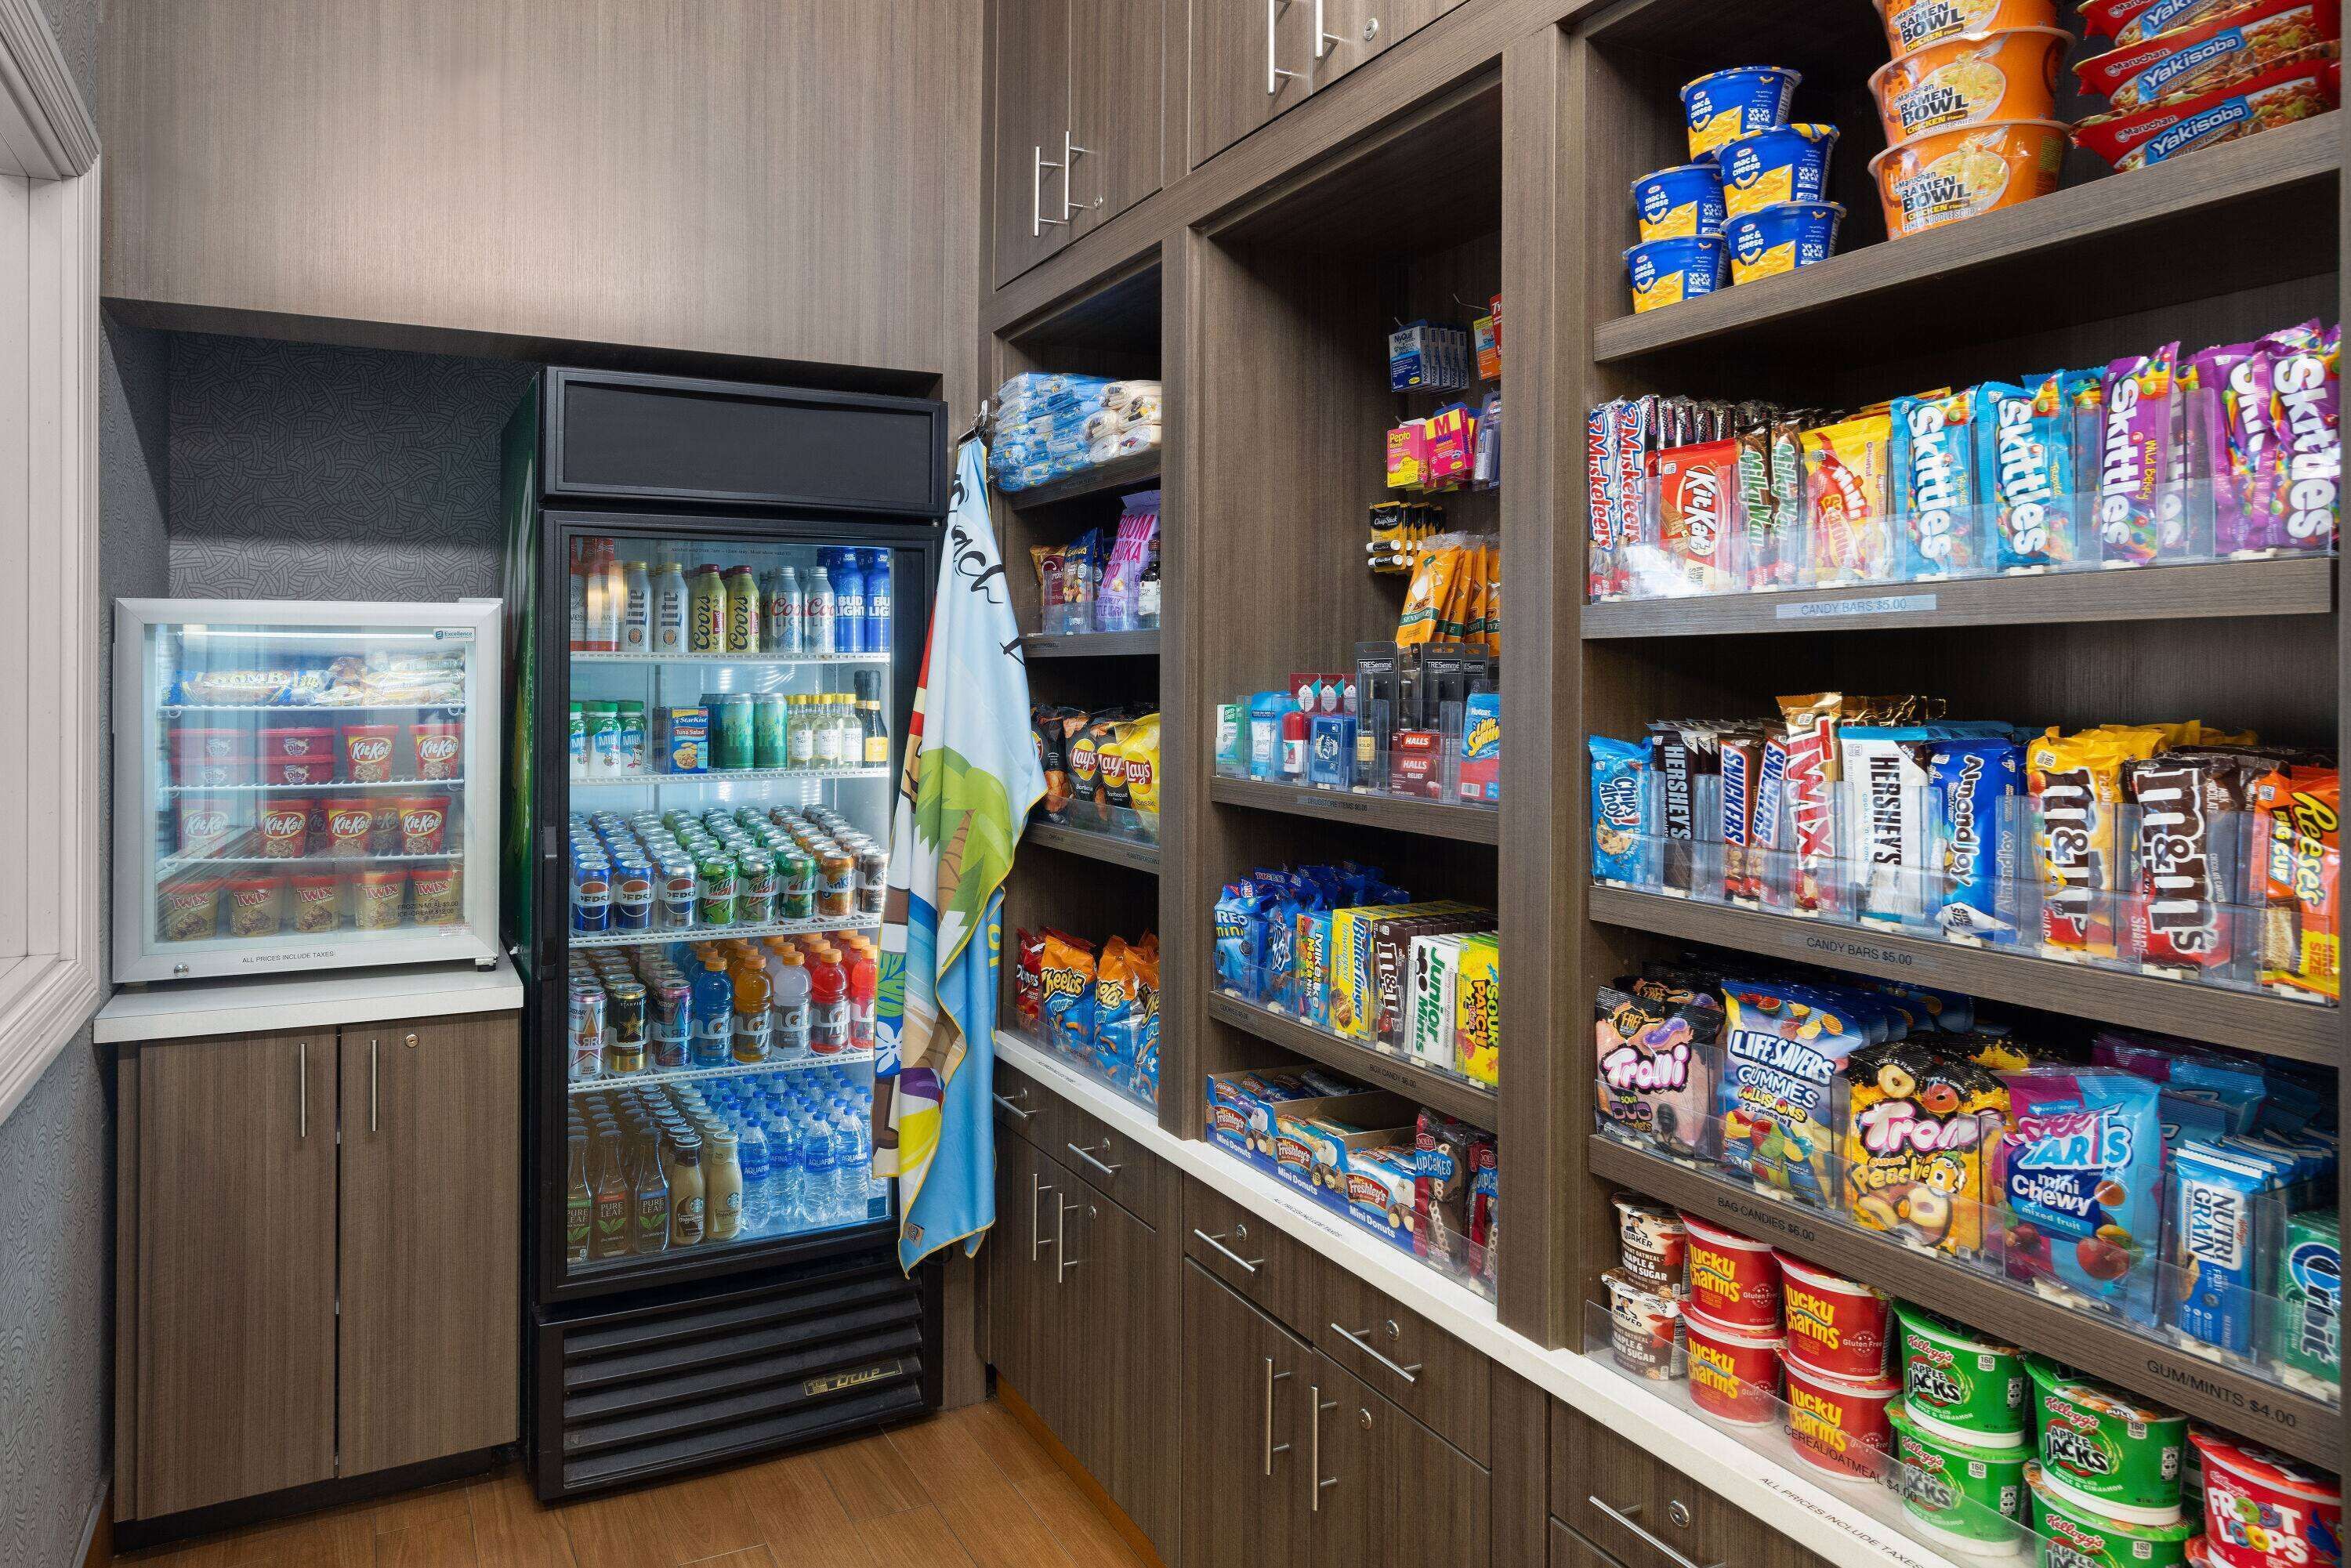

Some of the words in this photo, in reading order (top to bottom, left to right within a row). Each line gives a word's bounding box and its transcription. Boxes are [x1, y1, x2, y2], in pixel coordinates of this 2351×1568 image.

[1901, 2, 1949, 30] RAMEN
[1902, 9, 1965, 43] BOWL
[2115, 49, 2168, 70] Maruchan
[2142, 36, 2237, 89] Yakisoba
[1691, 103, 1713, 119] cheese
[1900, 87, 1954, 114] RAMEN
[1902, 95, 1969, 127] BOWL
[1907, 116, 1947, 134] CHICKEN
[2125, 115, 2176, 136] Maruchan
[2153, 105, 2244, 156] Yakisoba
[1733, 161, 1760, 176] cheese
[1902, 176, 1955, 197] RAMEN
[1903, 183, 1971, 212] BOWL
[1645, 197, 1669, 212] cheese
[1737, 237, 1763, 251] cheese
[1635, 267, 1655, 281] cheese
[2103, 378, 2140, 545] Skittles
[2145, 440, 2157, 468] Wild
[1907, 406, 1958, 559] Skittles
[1998, 398, 2050, 554] Skittles
[838, 596, 863, 606] BUD
[1802, 603, 1839, 615] CANDY
[1842, 601, 1872, 613] BARS
[1877, 599, 1907, 610] $5.00
[694, 595, 711, 650] Coors
[729, 595, 748, 650] Coors
[623, 736, 641, 744] MILK
[1405, 735, 1429, 745] HALLS
[1125, 762, 1150, 784] Lay's
[1403, 760, 1427, 770] HALLS
[1664, 744, 1692, 839] HERSHEY'S
[1723, 747, 1744, 846] SNICKERS
[1954, 755, 1984, 852] Almond
[1870, 757, 1902, 865] HERSHEY'S
[2273, 810, 2292, 841] BIG
[2272, 842, 2293, 881] CUP
[2293, 791, 2338, 907] Reese's
[282, 952, 310, 961] INCLUDE
[313, 951, 334, 959] TAXES
[1806, 937, 1844, 952] CANDY
[1848, 944, 1878, 959] BARS
[1882, 951, 1912, 965] $5.00
[1353, 920, 1367, 1020] Butterfinger
[1427, 947, 1446, 1044] Junior
[1416, 995, 1428, 1053] Mints
[1473, 980, 1491, 1048] PATCH
[1487, 985, 1498, 1047] SOUR
[1605, 1044, 1690, 1088] Trolli
[1737, 1066, 1820, 1109] GUMMIES
[1751, 1106, 1780, 1121] FLAVORS
[1216, 1133, 1229, 1146] Mini
[1230, 1140, 1252, 1159] Donuts
[1277, 1143, 1310, 1164] Freshley's
[1277, 1166, 1292, 1181] Mini
[1293, 1175, 1317, 1196] Donuts
[1349, 1180, 1386, 1204] Freshley's
[2011, 1173, 2091, 1217] Chewy
[2038, 1171, 2080, 1195] mini
[643, 1198, 665, 1207] PURE
[1718, 1197, 1738, 1212] BAG
[1741, 1206, 1785, 1230] CANDIES
[1788, 1224, 1814, 1241] $6.00
[2021, 1204, 2053, 1222] mixed
[2056, 1214, 2082, 1232] fruit
[1349, 1205, 1366, 1222] Mini
[1367, 1215, 1396, 1238] Donuts
[2192, 1186, 2216, 1265] GRAIN
[2211, 1191, 2238, 1272] NUTRI
[1624, 1230, 1653, 1249] QUAKER
[1639, 1266, 1668, 1281] SUGAR
[1690, 1244, 1737, 1280] Lucky
[1690, 1268, 1741, 1302] Charms
[1786, 1284, 1835, 1323] Lucky
[1787, 1312, 1840, 1350] Charms
[1907, 1334, 1953, 1362] Kellogg's
[1627, 1348, 1655, 1363] SUGAR
[1689, 1338, 1735, 1374] Lucky
[1911, 1362, 1947, 1382] APPLE
[1688, 1360, 1740, 1400] Charms
[1908, 1367, 1962, 1405] JACKS
[2147, 1360, 2244, 1407] GUM/MINTS
[2250, 1400, 2296, 1428] $4.00
[1790, 1385, 1842, 1423] Lucky
[2045, 1396, 2099, 1429] Kellogg's
[1790, 1407, 1846, 1451] Charms
[2051, 1429, 2090, 1448] APPLE
[1784, 1424, 1882, 1486] CEREAL/OATMEAL
[1902, 1436, 1943, 1466] Kellogg's
[2046, 1436, 2110, 1475] JACKS
[1759, 1478, 1777, 1491] ALL
[1780, 1490, 1826, 1515] PRICES
[1824, 1514, 1882, 1546] INCLUDE
[2207, 1487, 2302, 1536] FROOT
[2046, 1513, 2104, 1547] Kellogg's
[2216, 1516, 2309, 1565] LOOPS
